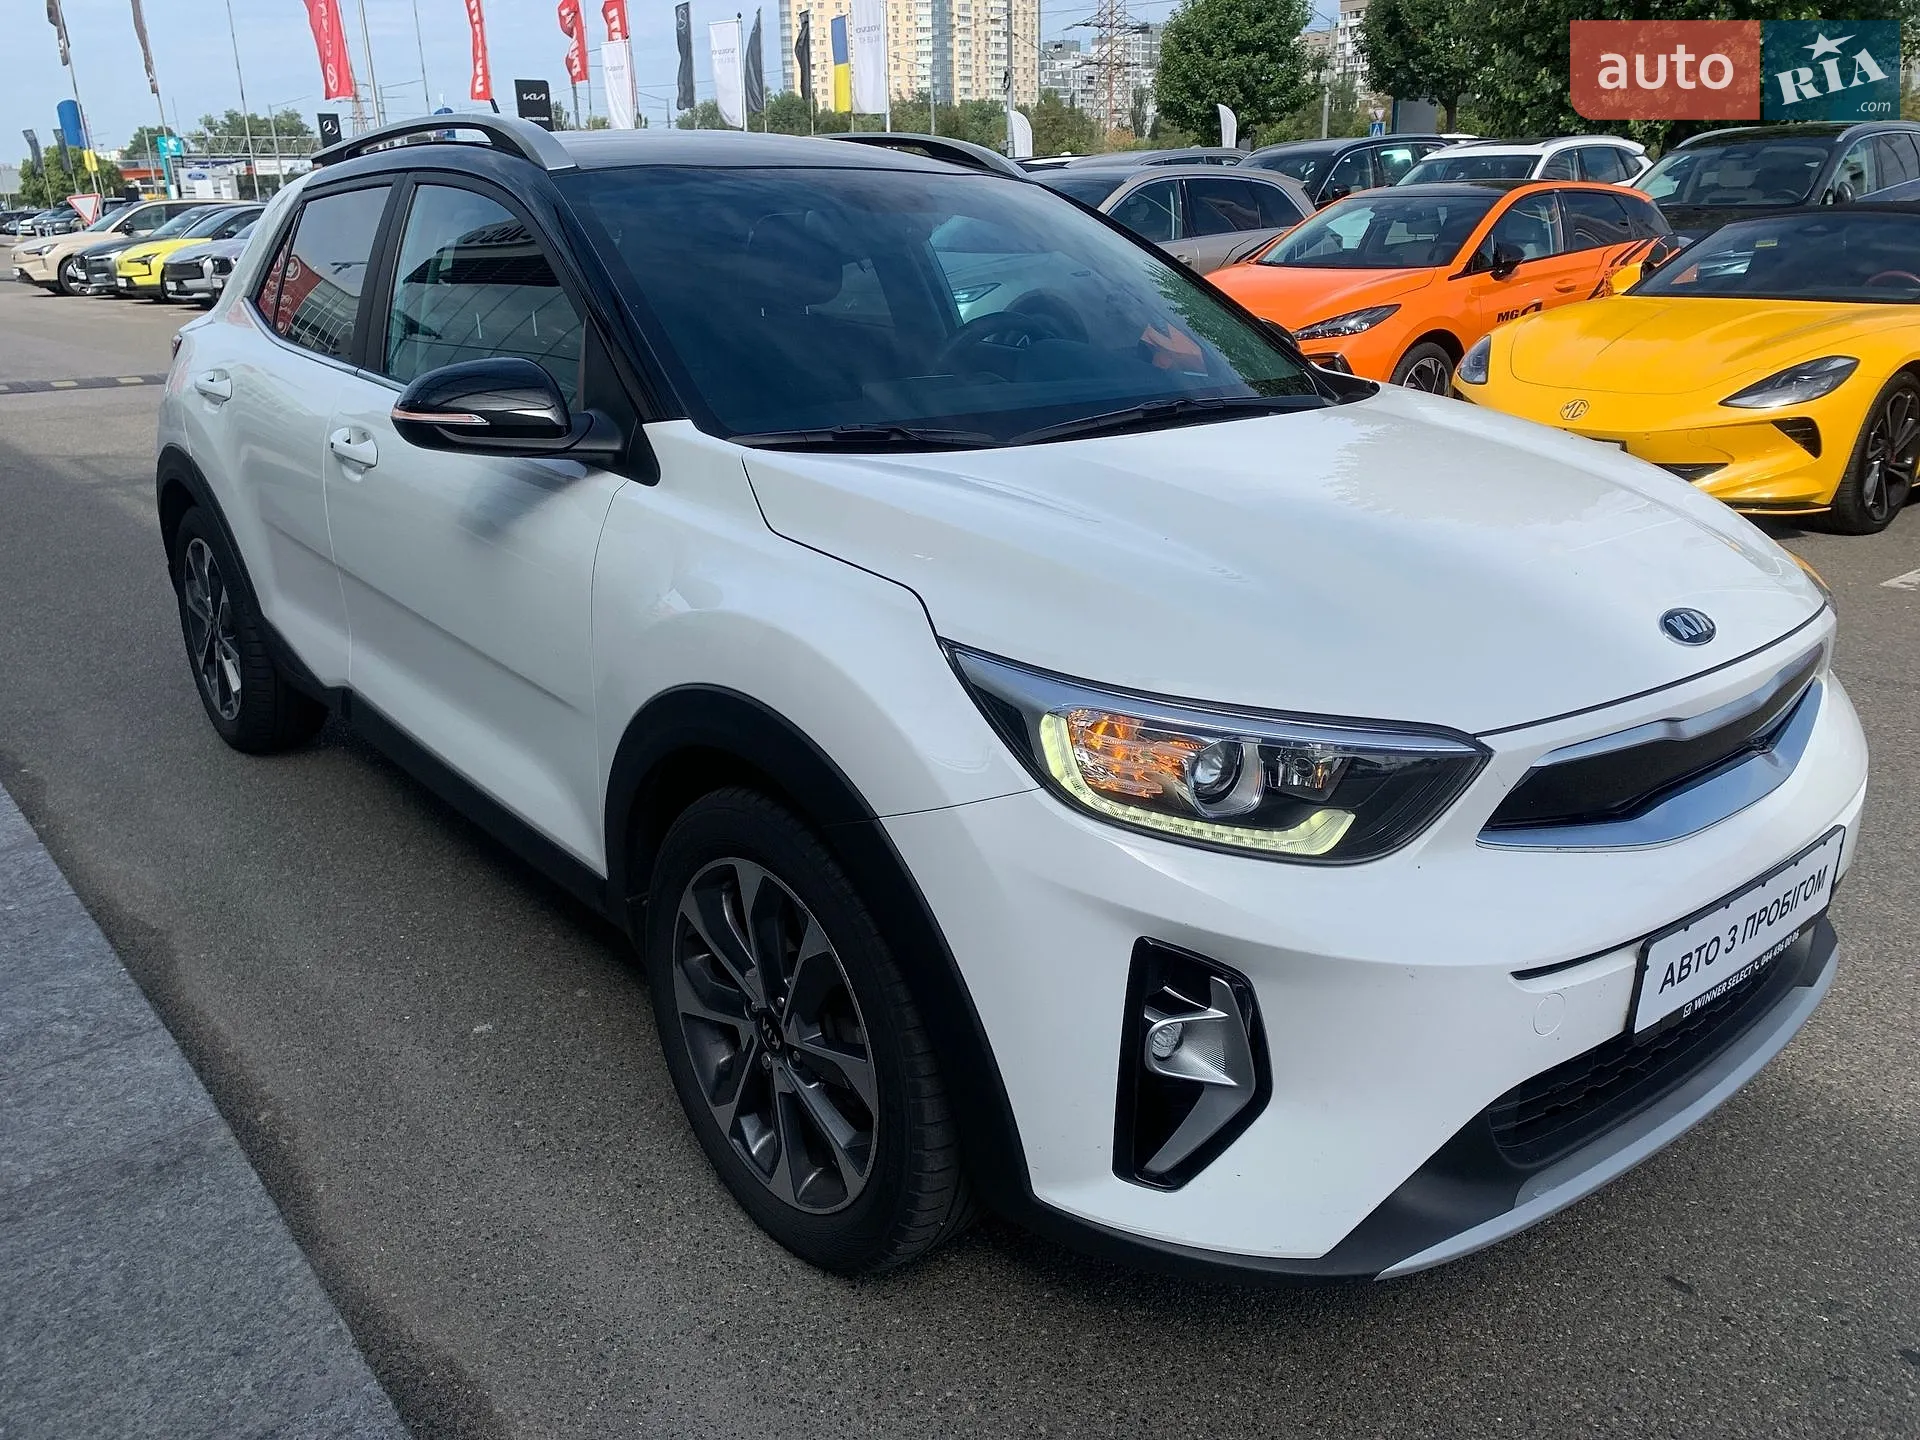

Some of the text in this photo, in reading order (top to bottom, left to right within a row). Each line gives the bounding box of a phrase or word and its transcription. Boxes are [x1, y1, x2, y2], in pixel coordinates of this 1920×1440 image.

[1658, 936, 1721, 995] АВТО
[1741, 864, 1829, 944] ПРОБІГОМ
[1694, 982, 1727, 1010] WINNER
[1727, 963, 1754, 990] SELECT
